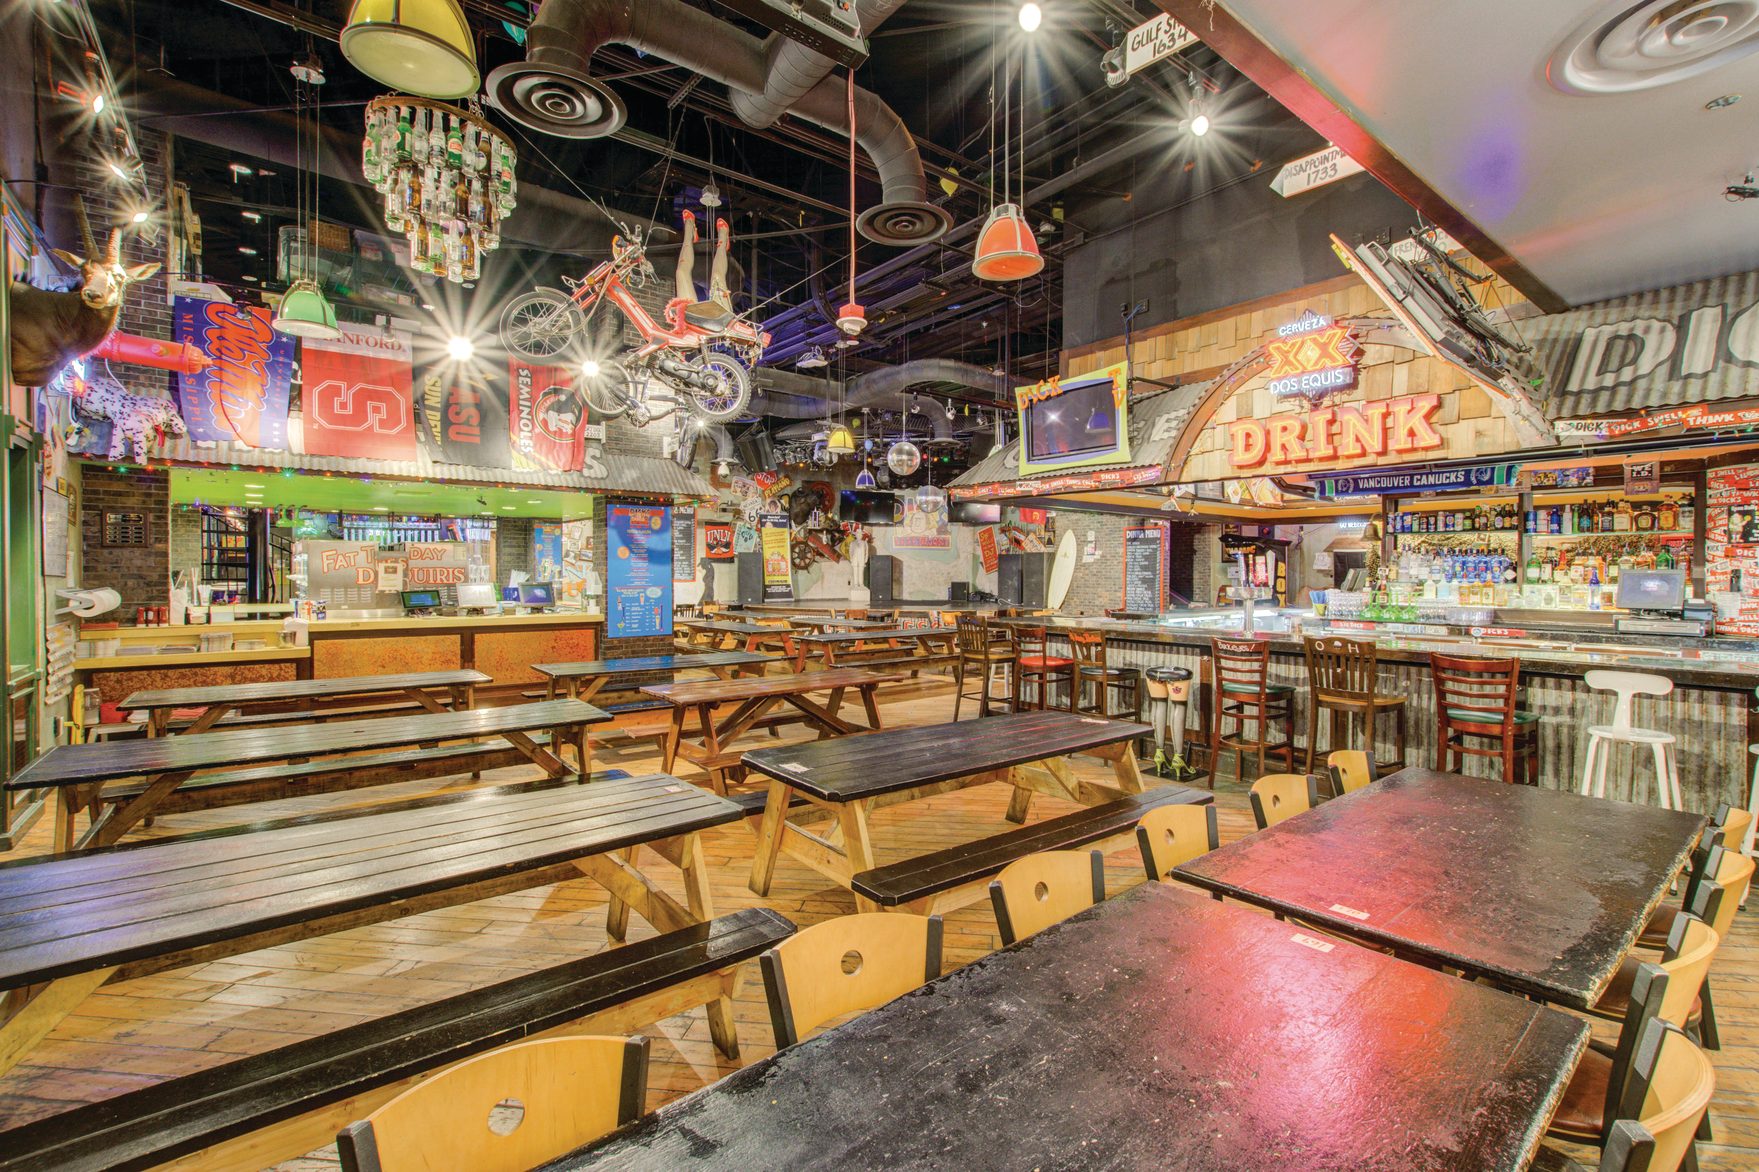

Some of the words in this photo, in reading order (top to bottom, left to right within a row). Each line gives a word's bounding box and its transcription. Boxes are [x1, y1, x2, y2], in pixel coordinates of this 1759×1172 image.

[1131, 21, 1162, 52] GULF
[1152, 29, 1188, 58] 1634
[1306, 163, 1338, 186] 1733
[1279, 316, 1328, 336] CERVEZA
[311, 331, 403, 352] ANFORD
[1268, 328, 1353, 379] XX
[423, 374, 442, 408] SUN
[1016, 375, 1064, 411] DICK
[1269, 380, 1299, 395] DOS
[1301, 369, 1345, 388] EQUIS
[447, 386, 481, 444] ASU
[517, 367, 534, 454] SEMINOLES
[1686, 413, 1735, 426] THINK
[1227, 394, 1443, 467] DRINK
[756, 472, 775, 485] STOP
[763, 477, 791, 499] PLAYLAND
[1357, 475, 1411, 489] VANCOUVER
[1412, 470, 1466, 487] CANUCKS
[706, 528, 732, 545] UNLV
[894, 537, 916, 547] LAST
[918, 536, 950, 547] RESORT
[1145, 529, 1161, 538] MENU
[321, 548, 359, 574] FAT
[984, 547, 995, 558] DJ
[355, 566, 466, 594] DUIRIS
[1275, 560, 1287, 608] BOX
